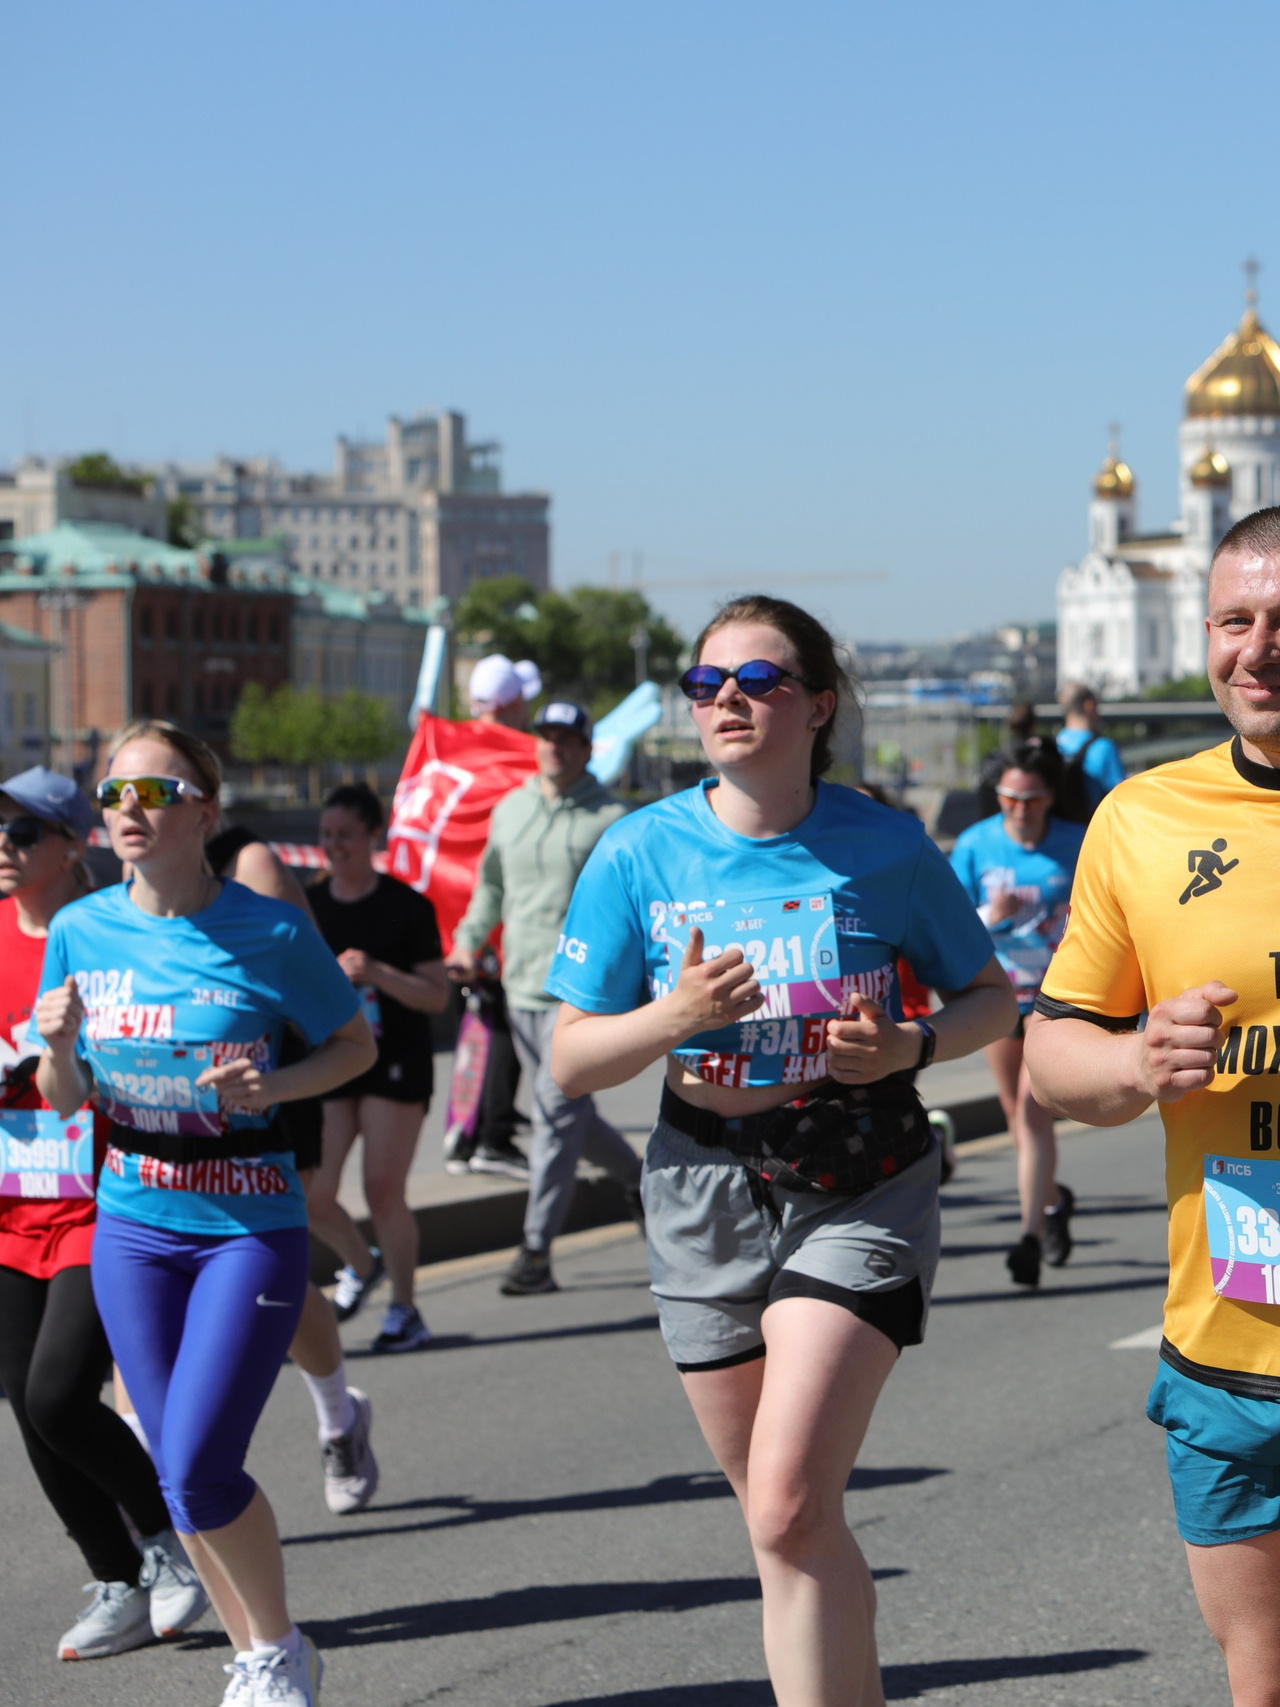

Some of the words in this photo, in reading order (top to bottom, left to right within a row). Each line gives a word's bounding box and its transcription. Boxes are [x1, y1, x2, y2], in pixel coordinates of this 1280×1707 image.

[689, 912, 713, 924] ПСБ
[703, 936, 805, 981] 241
[820, 950, 833, 965] D
[76, 969, 133, 1005] 2024
[740, 1018, 828, 1055] #ЗАБ
[1227, 1164, 1252, 1176] ПСБ
